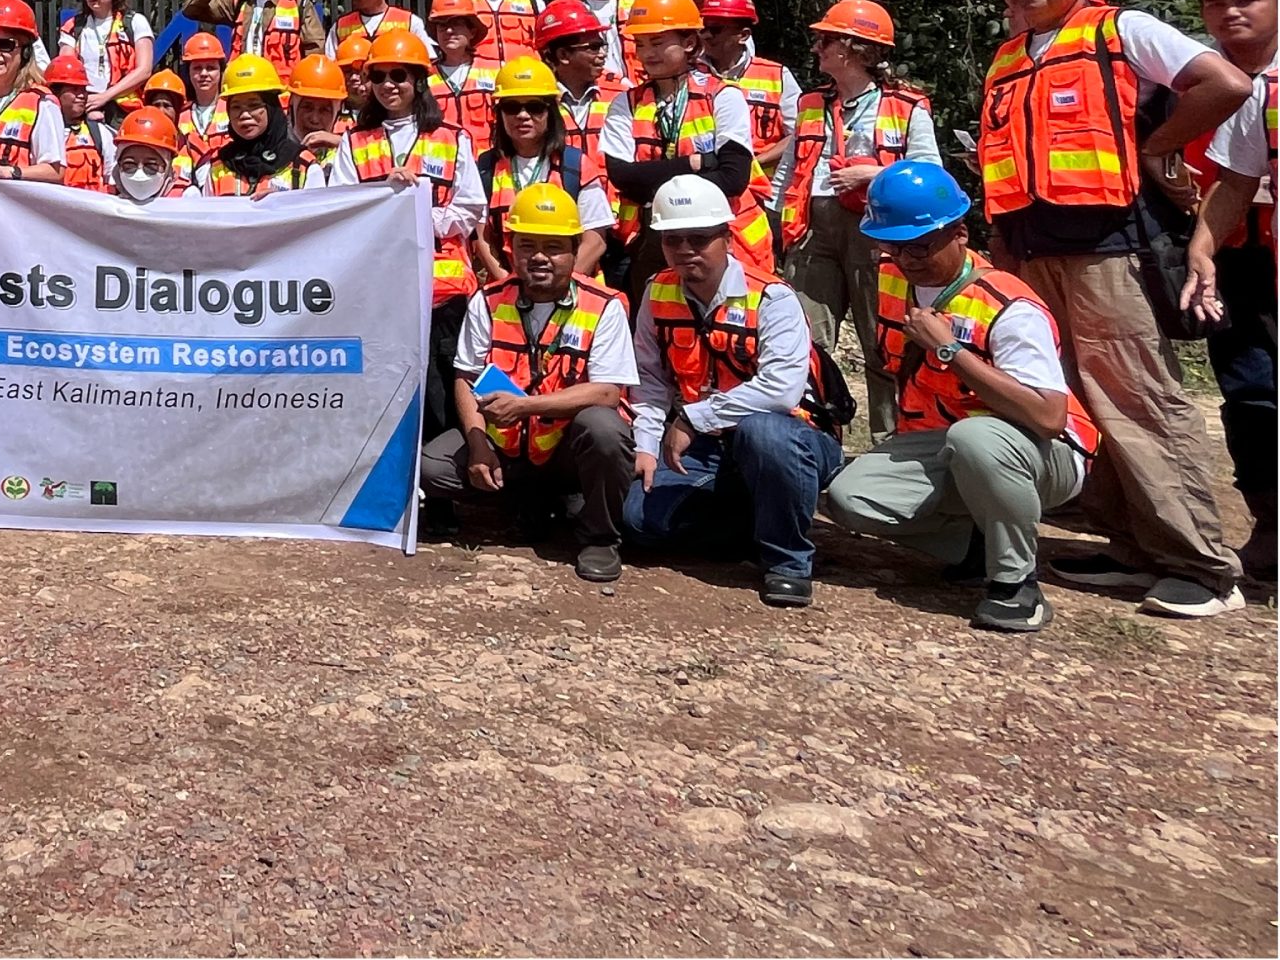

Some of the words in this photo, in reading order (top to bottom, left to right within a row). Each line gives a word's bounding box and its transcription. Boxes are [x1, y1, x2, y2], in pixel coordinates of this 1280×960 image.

[95, 264, 335, 326] Dialogue
[7, 335, 161, 368] Ecosystem
[172, 342, 347, 368] Restoration
[52, 381, 203, 412] Kalimantan,
[216, 388, 344, 410] Indonesia
